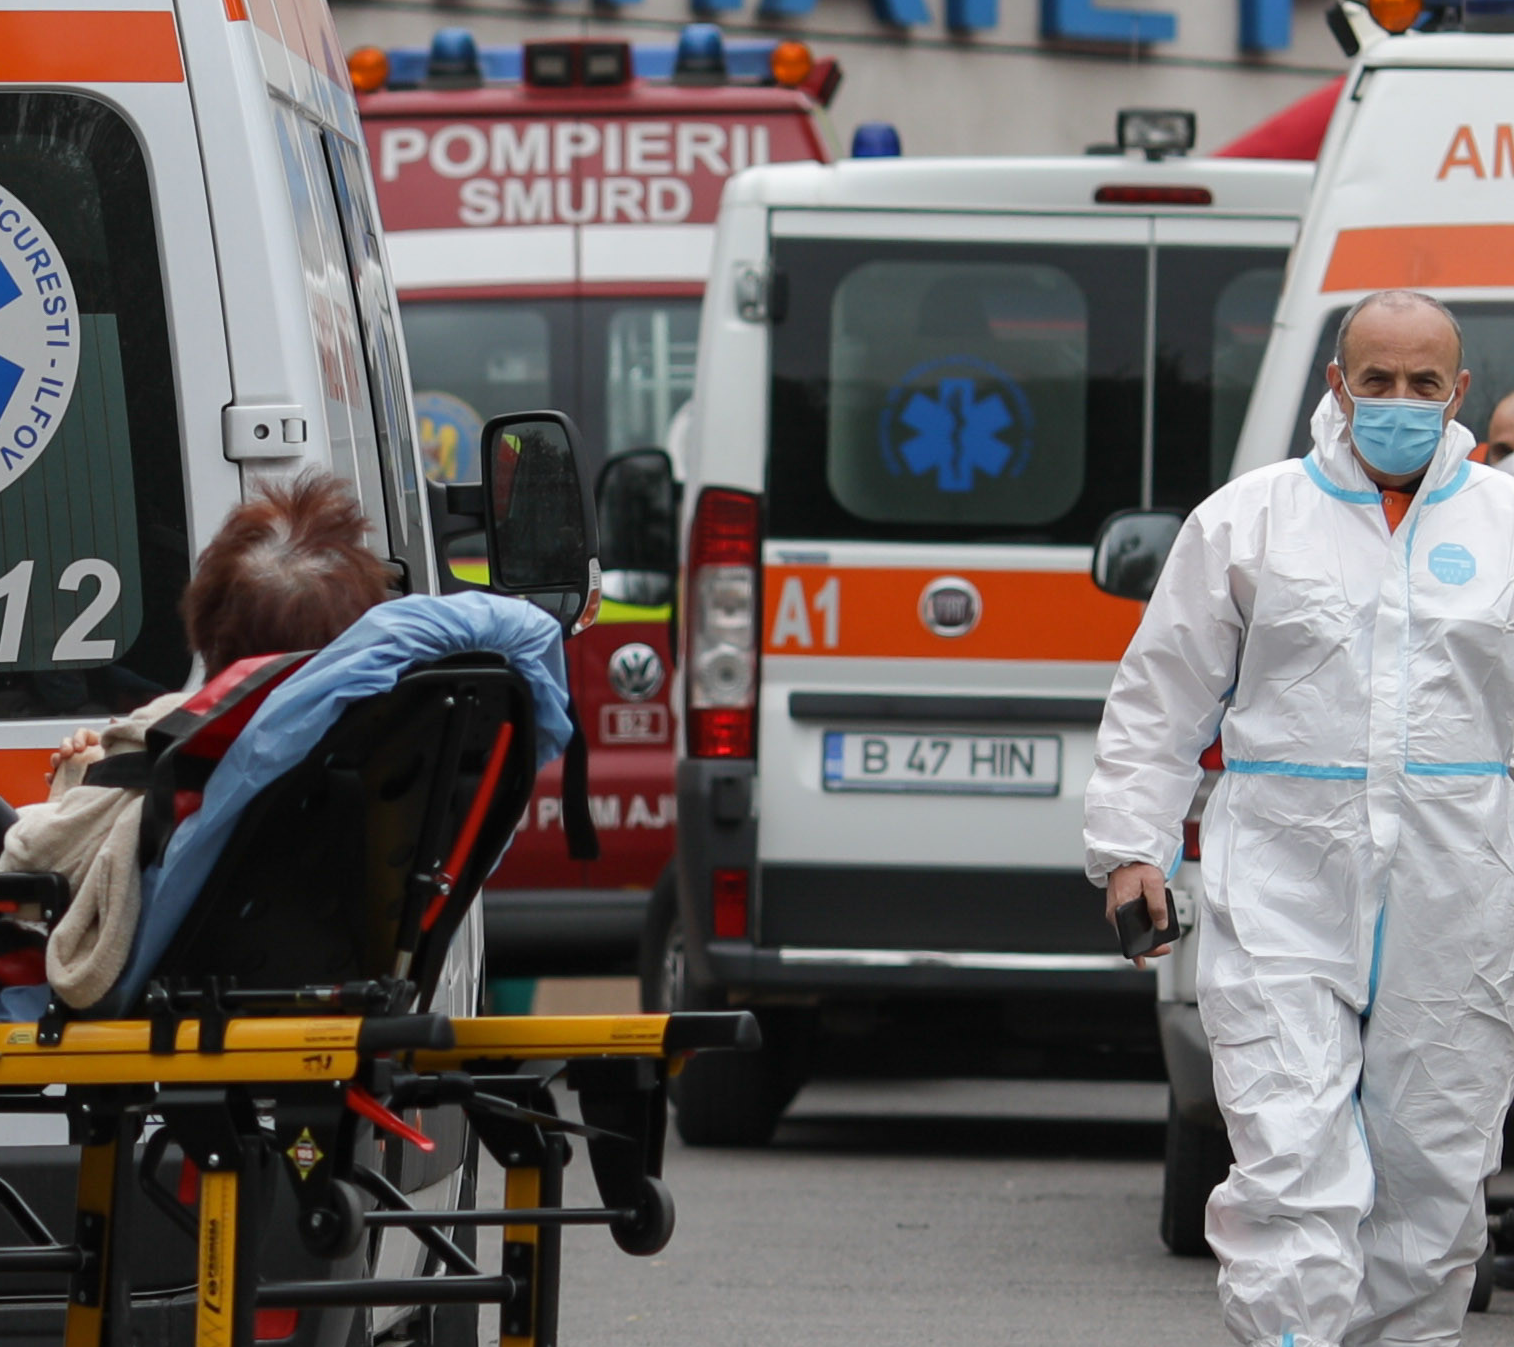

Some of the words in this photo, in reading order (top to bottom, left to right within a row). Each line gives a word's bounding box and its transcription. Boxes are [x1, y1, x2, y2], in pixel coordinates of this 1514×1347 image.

[379, 121, 769, 181] POMPIERII
[458, 177, 692, 225] SMURD
[771, 577, 840, 648] A1
[862, 740, 889, 774] B
[905, 741, 950, 775] 47
[971, 742, 1036, 776] HIN
